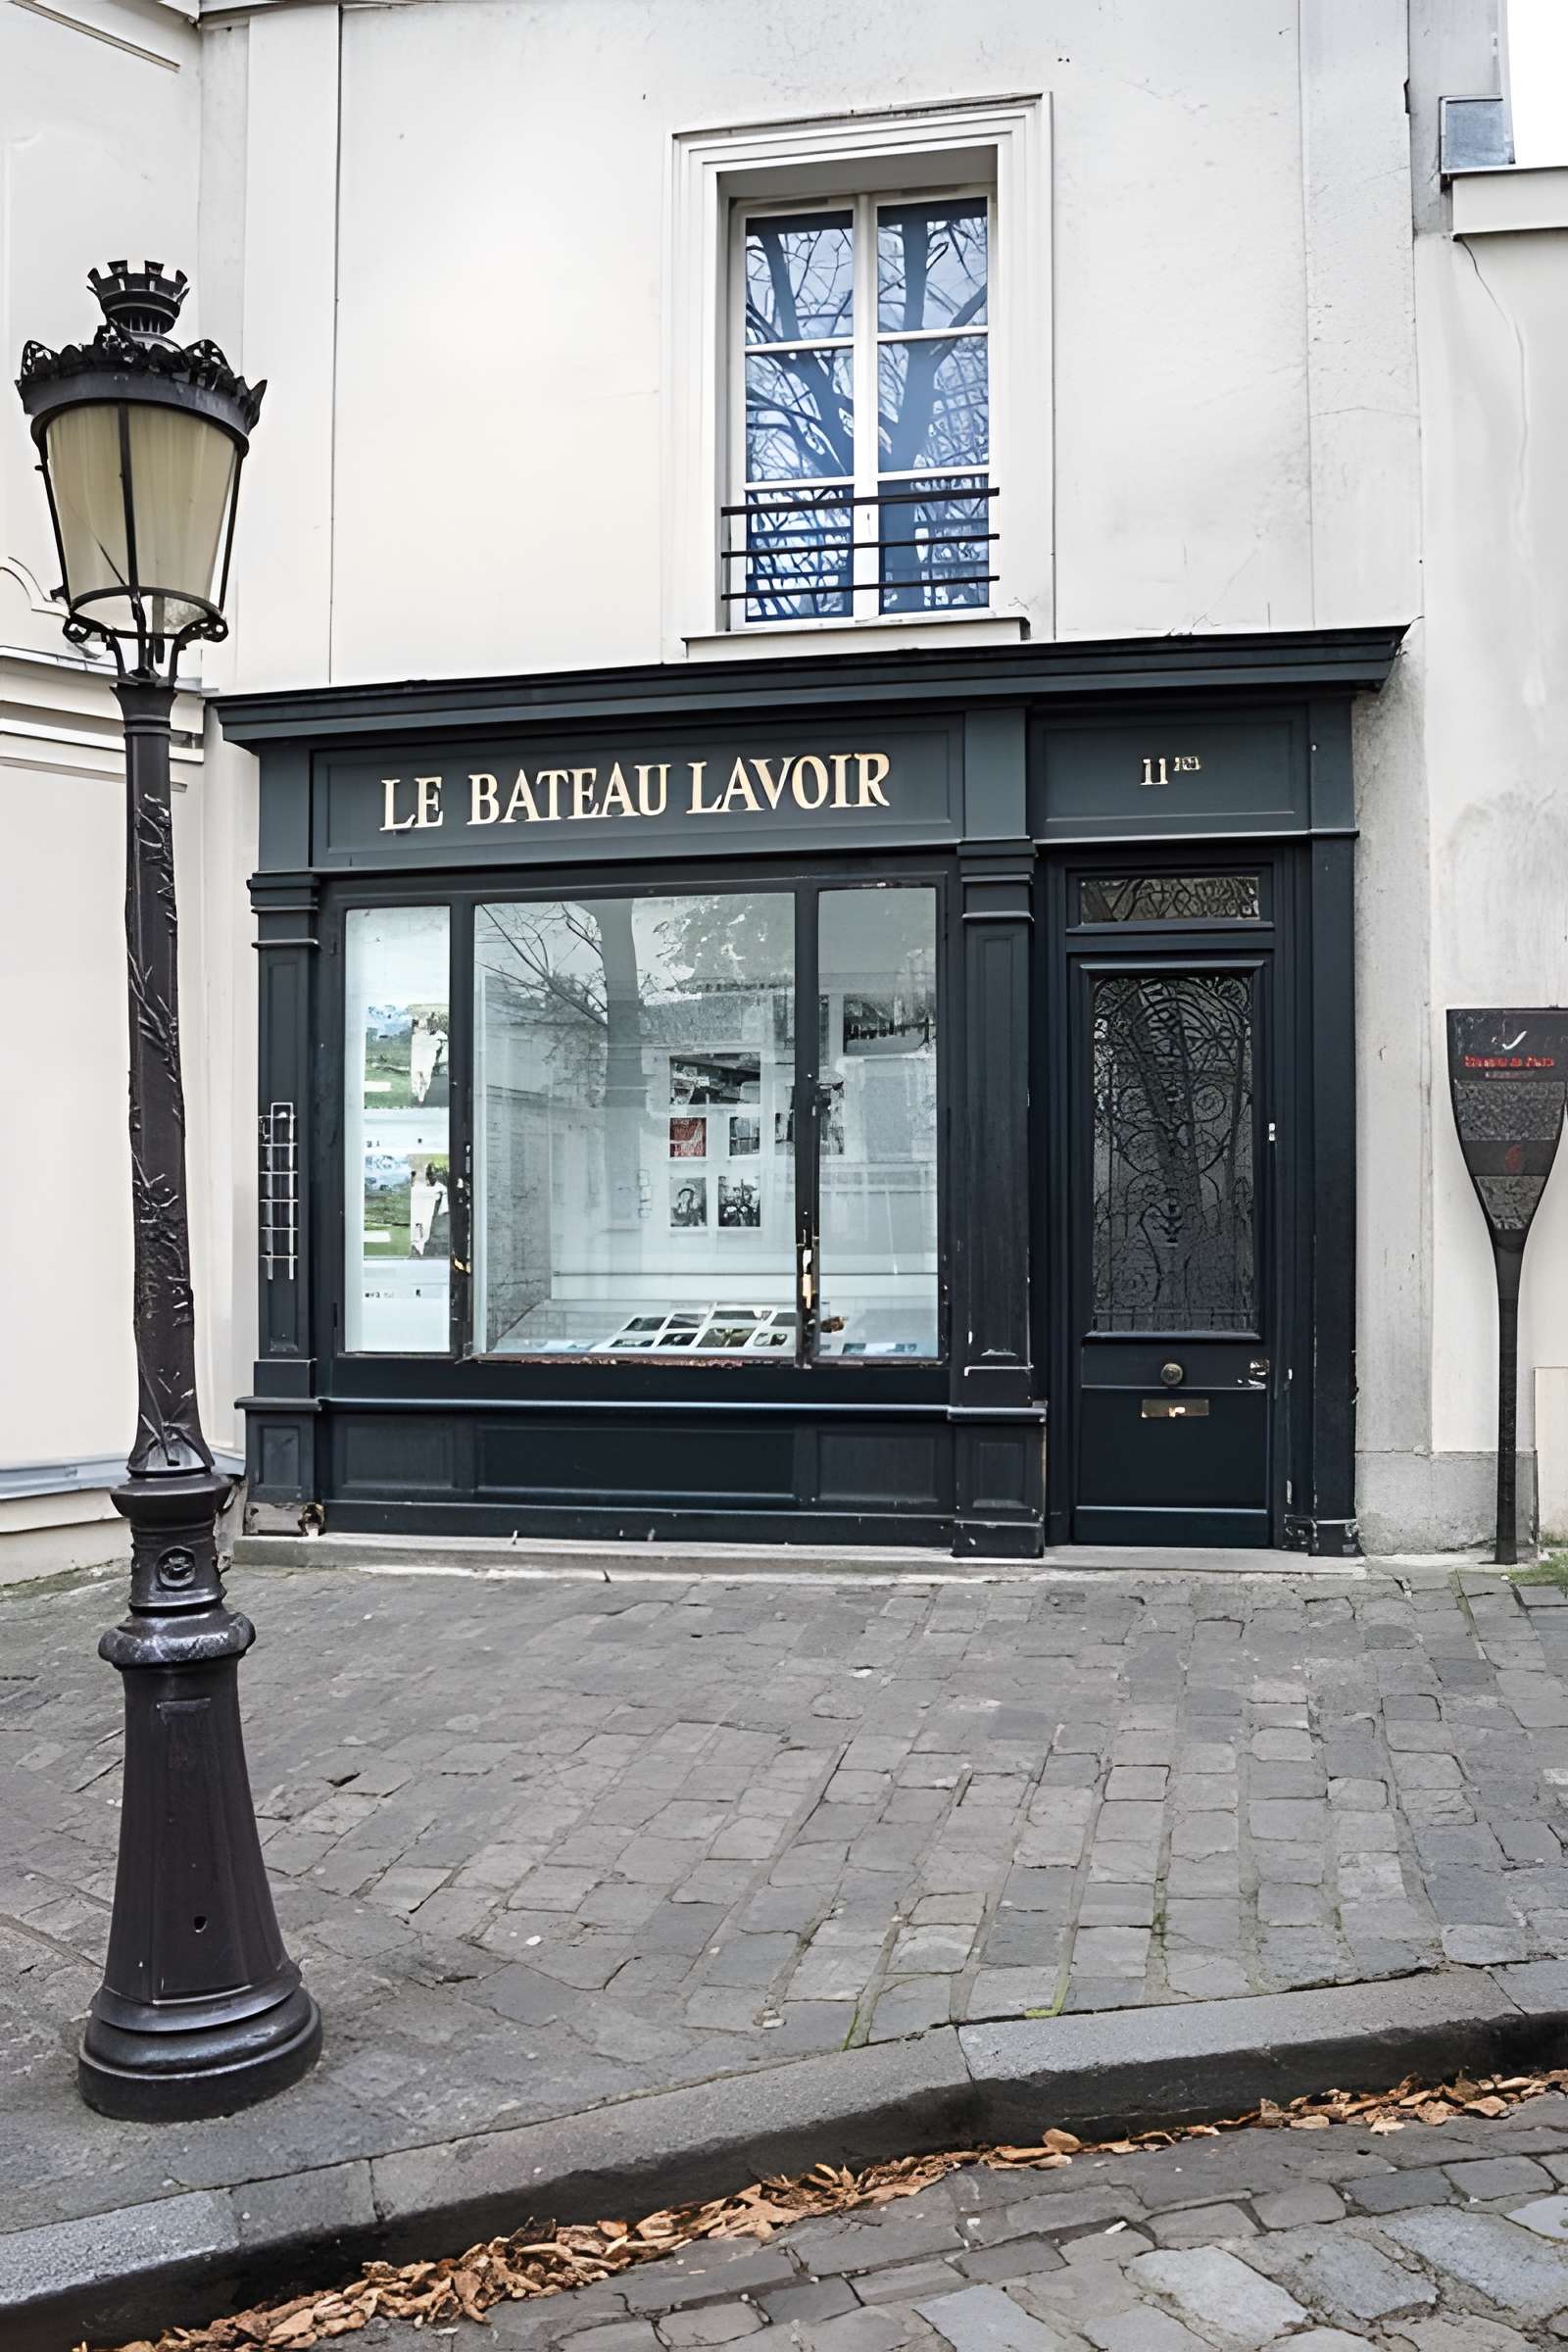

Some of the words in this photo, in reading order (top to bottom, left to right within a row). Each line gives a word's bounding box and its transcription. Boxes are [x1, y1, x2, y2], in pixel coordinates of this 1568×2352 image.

[379, 776, 444, 831] LE
[466, 761, 672, 826] BATEAU
[686, 752, 891, 814] LAVOIR
